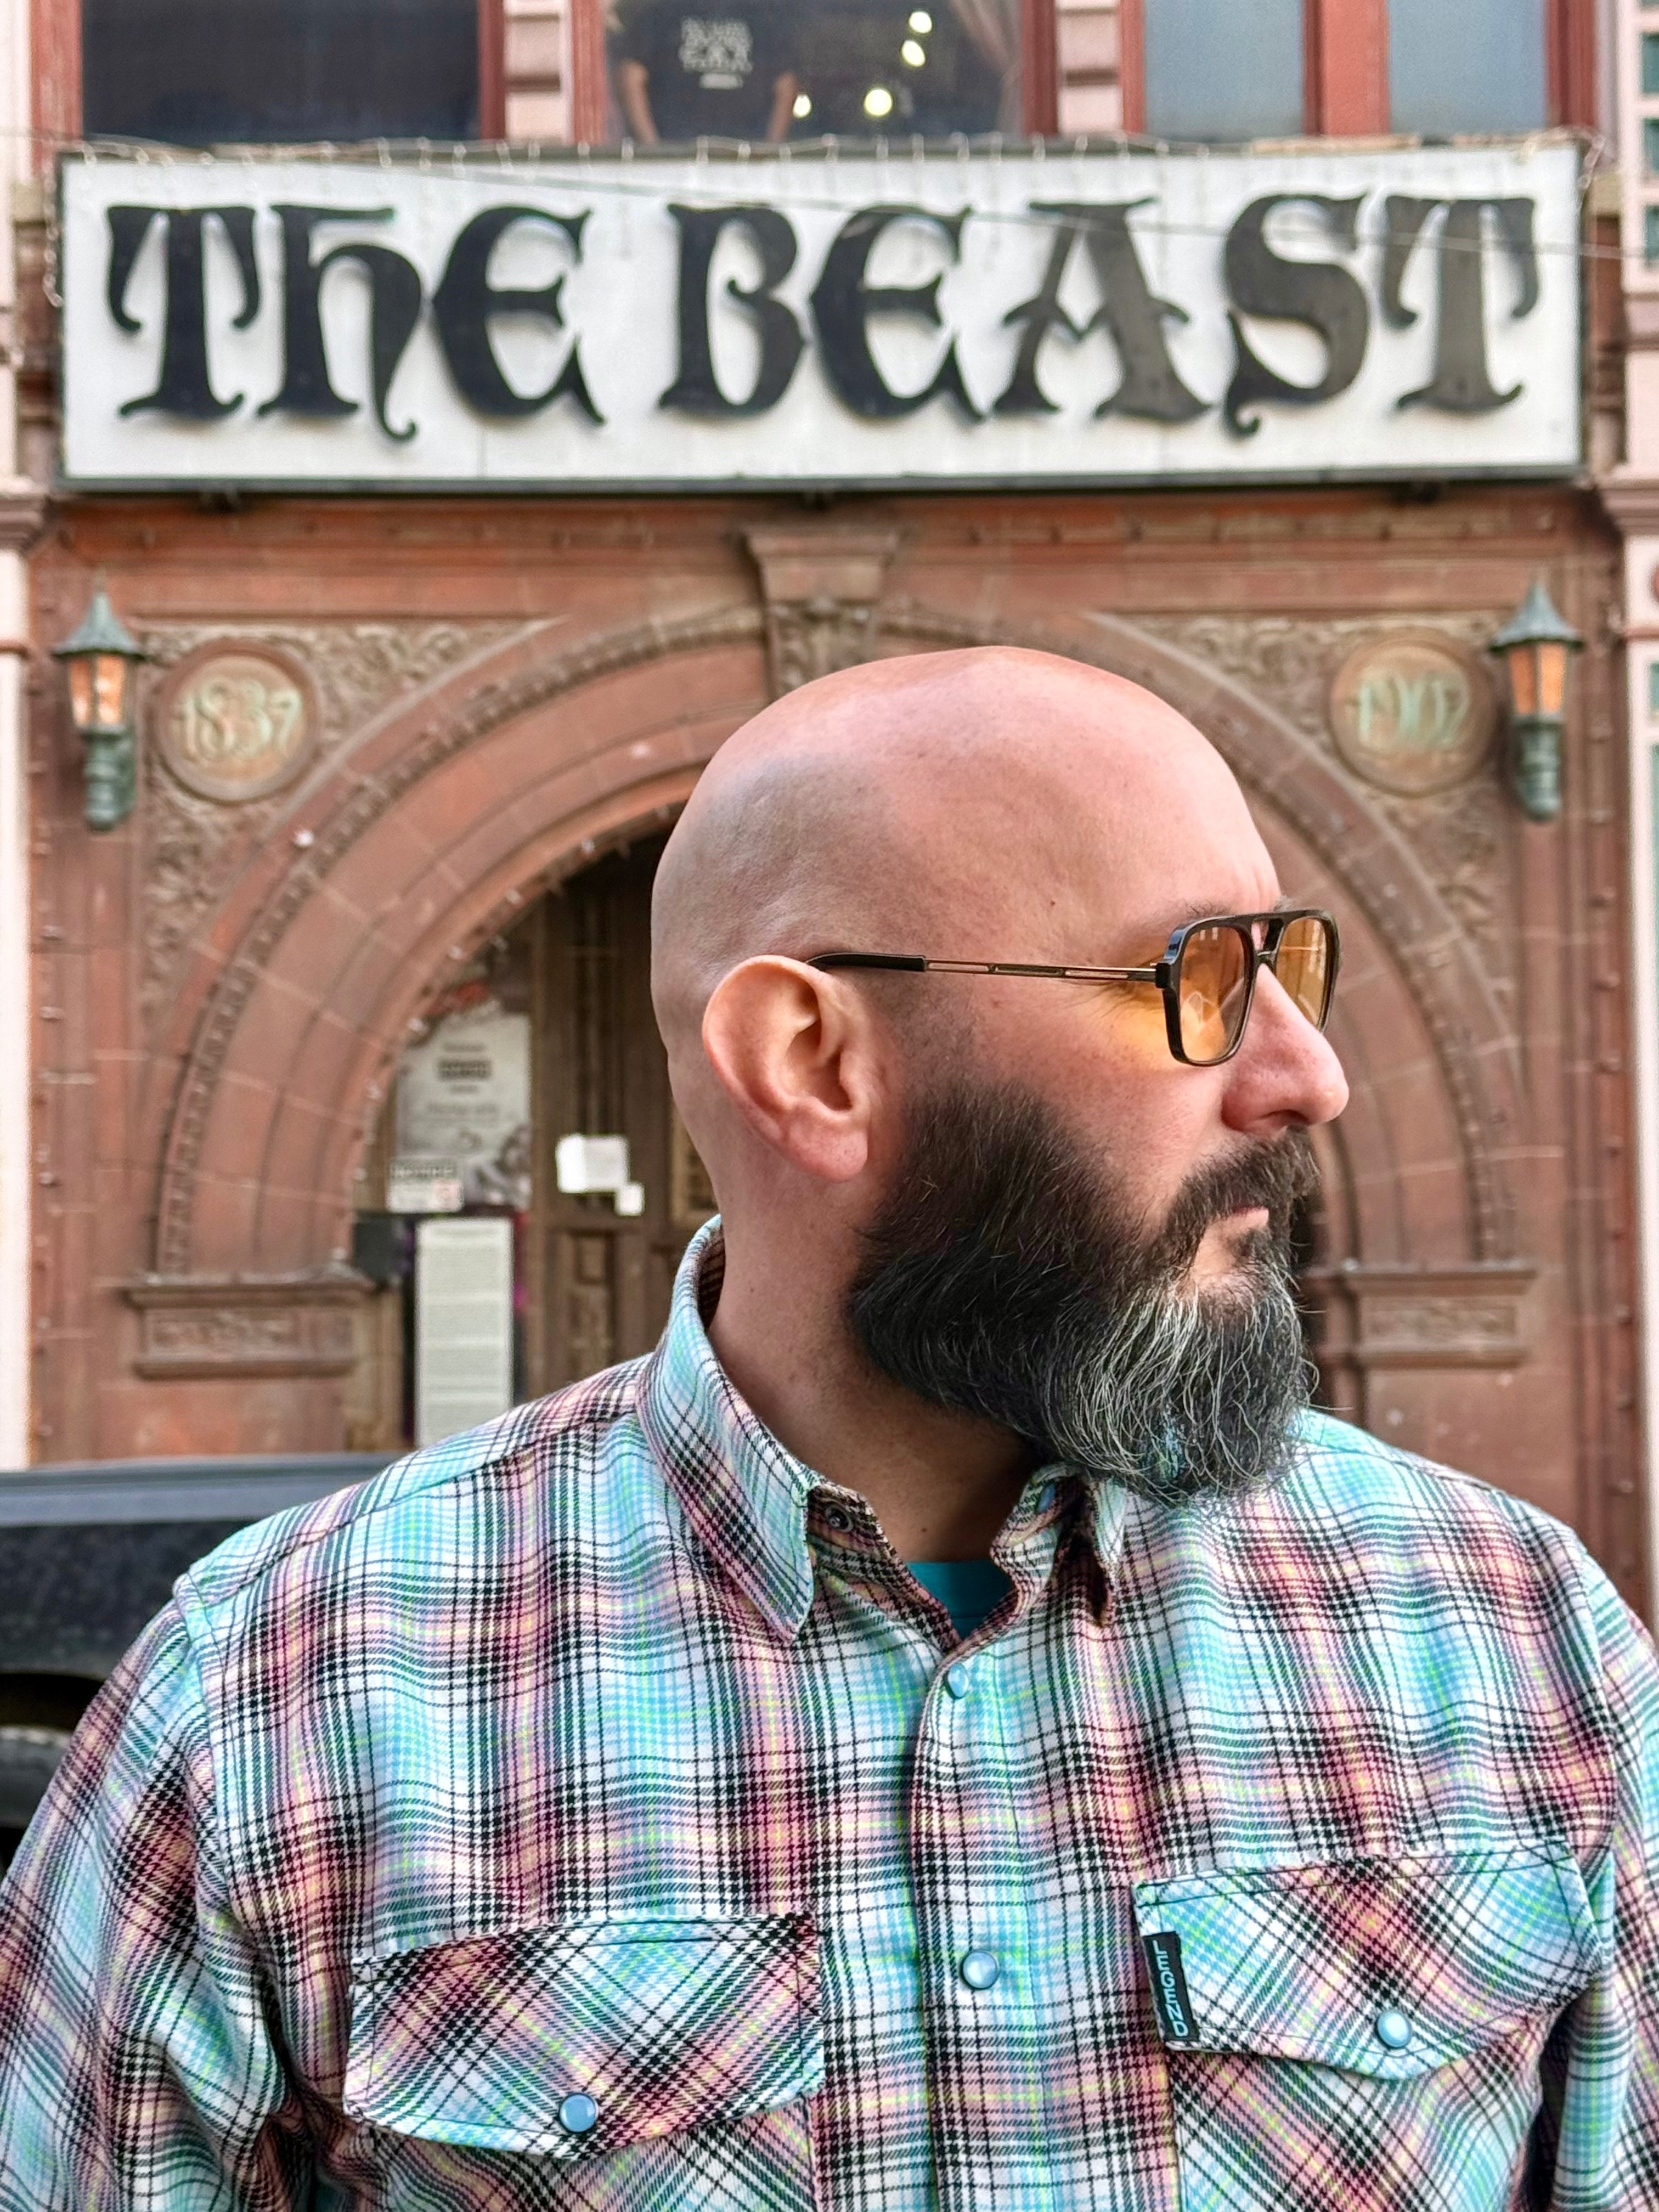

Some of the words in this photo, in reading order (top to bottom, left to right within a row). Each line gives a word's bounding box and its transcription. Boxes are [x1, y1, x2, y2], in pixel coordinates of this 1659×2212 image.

[106, 203, 606, 440] THE
[657, 193, 1537, 438] BEAST
[1153, 1939, 1189, 2038] LEGEND
